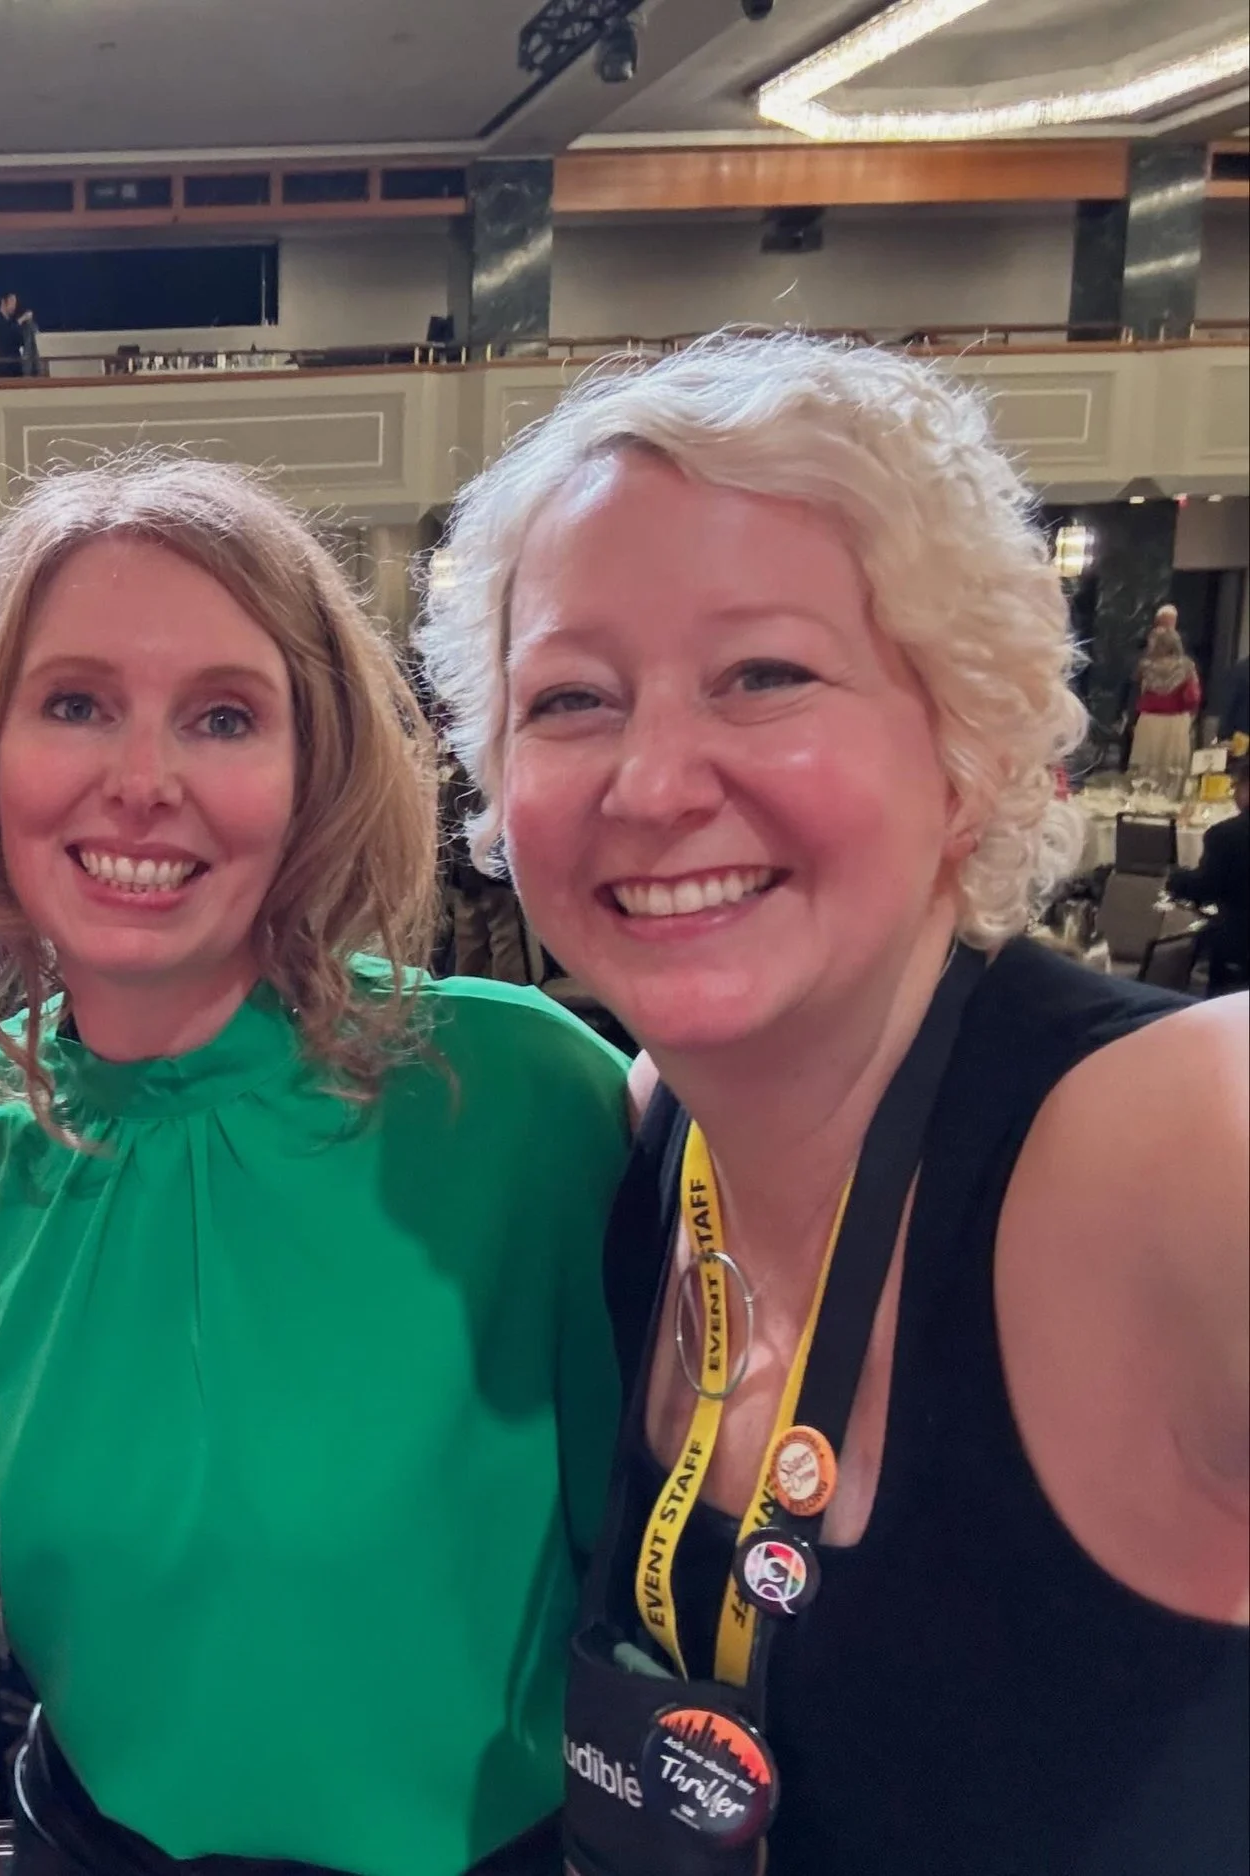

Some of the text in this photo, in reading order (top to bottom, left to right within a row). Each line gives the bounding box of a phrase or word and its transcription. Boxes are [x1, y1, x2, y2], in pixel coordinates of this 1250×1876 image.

[690, 1178, 722, 1371] EVENT STAFF
[644, 1441, 704, 1627] EVENT STAFF
[660, 1754, 746, 1818] Thriller
